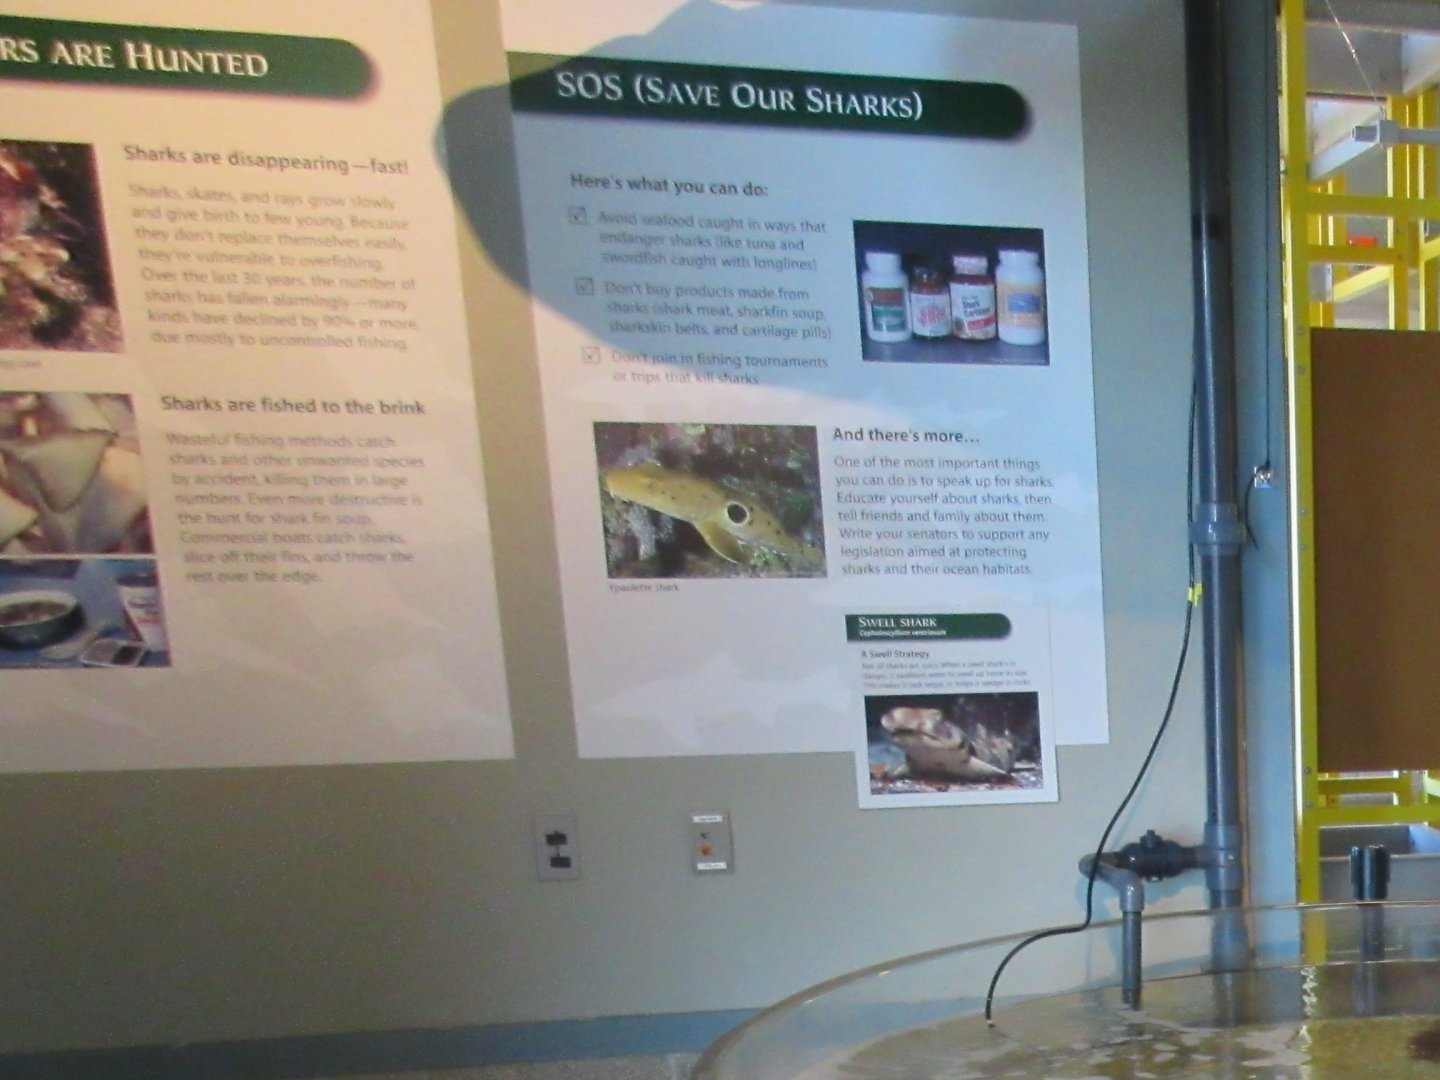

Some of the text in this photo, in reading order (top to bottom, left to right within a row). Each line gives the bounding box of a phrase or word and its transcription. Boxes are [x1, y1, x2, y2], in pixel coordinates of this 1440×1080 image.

[557, 71, 624, 100] SOS
[124, 146, 186, 163] Sharks
[193, 153, 221, 165] are
[571, 174, 768, 198] Here's what you can do:
[241, 190, 395, 213] and rays grow slowly
[131, 207, 161, 220] and
[166, 208, 198, 225] give
[203, 209, 239, 223] birth
[244, 213, 259, 224] to
[264, 212, 291, 226] few
[350, 216, 409, 231] Because
[600, 211, 826, 236] Avoid seafood caught in ways that
[135, 226, 168, 244] they
[219, 230, 272, 247] replace
[278, 232, 361, 248] themselves
[600, 232, 665, 250] endanger
[670, 234, 711, 248] sharks
[746, 238, 776, 250] tuna
[780, 238, 804, 251] and
[196, 249, 275, 264] vulnerable
[280, 253, 296, 265] to
[601, 252, 817, 275] swordfish caught with longlines)
[141, 267, 416, 290] Over the last 30 the number of
[145, 288, 268, 304] sharks has fallen
[605, 281, 809, 300] Don't buy products made from
[147, 308, 188, 322] kinds
[193, 310, 228, 323] have
[233, 311, 297, 325] declined
[302, 313, 318, 330] by
[360, 318, 376, 328] or
[606, 301, 649, 314] sharks
[737, 305, 788, 318] sharkfin
[151, 331, 179, 343] due
[185, 332, 234, 349] mostly
[239, 334, 255, 345] to
[260, 334, 353, 348] uncontrolled
[609, 320, 671, 334] sharkskin
[713, 323, 738, 335] and
[742, 324, 798, 341] cartilage
[802, 325, 832, 342] pills)
[611, 350, 829, 370] Don't join in fishing tournaments
[613, 370, 760, 387] or trips that kill sharks
[161, 396, 425, 415] Sharks are fished to the brink
[833, 428, 863, 441] And
[869, 428, 919, 442] there's
[834, 455, 1040, 473] One of the most important things
[835, 474, 1054, 491] you can do is to speak up for sharks.
[837, 492, 886, 504] Educate
[889, 492, 939, 508] yourself
[942, 492, 978, 504] about
[1024, 492, 1052, 504] then
[838, 509, 1048, 525] tell friends and family about them.
[839, 527, 1050, 544] Write your senators to support any
[841, 545, 1027, 561] legislation aimed at protecting
[842, 562, 1033, 574] sharks and their ocean habitats.
[870, 650, 892, 658] Swell
[894, 650, 930, 660] Strategy
